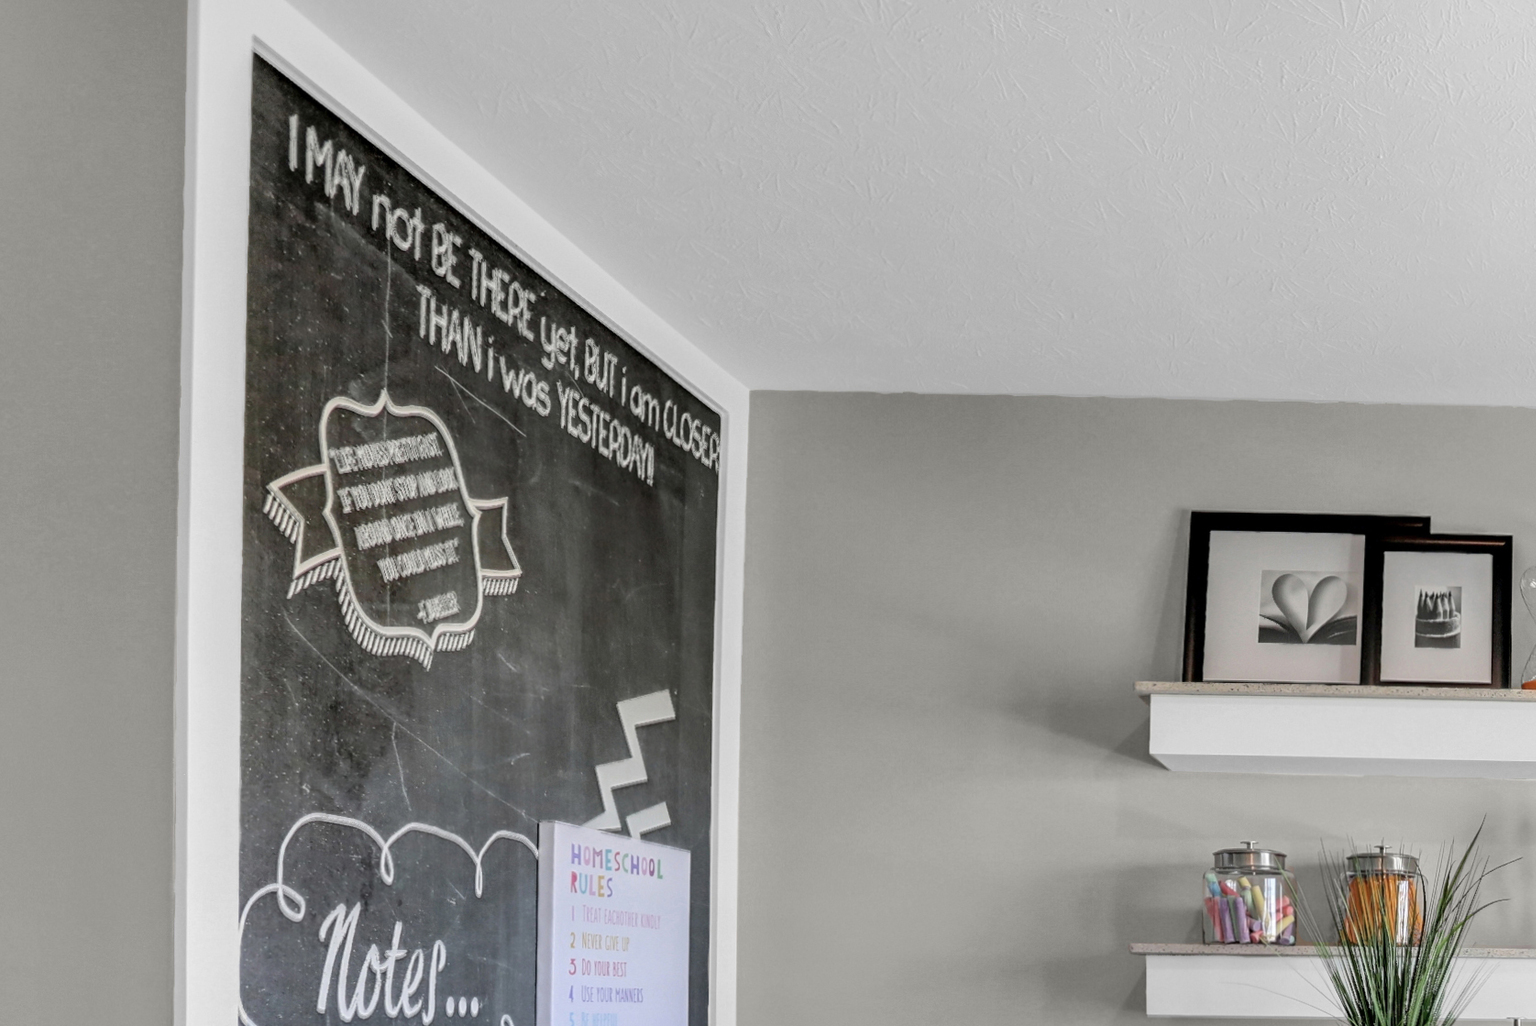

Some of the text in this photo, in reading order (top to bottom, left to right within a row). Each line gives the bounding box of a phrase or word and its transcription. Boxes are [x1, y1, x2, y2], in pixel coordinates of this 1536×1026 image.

[288, 114, 298, 172] I
[305, 125, 366, 216] MAY
[371, 194, 425, 262] not
[431, 222, 464, 290] BE
[468, 247, 537, 342] THERE
[584, 337, 619, 399] BUT
[629, 384, 661, 433] am
[662, 399, 721, 475] CLOSER
[415, 284, 482, 374] THAN
[500, 355, 552, 417] was
[571, 843, 664, 880] HOMESCHOOL
[570, 871, 613, 898] RULES
[582, 904, 602, 924] TREAT
[570, 932, 631, 952] 2 NEVER GIVE UP
[568, 958, 627, 978] 3 DO YOUR BEST
[568, 985, 644, 1003] 4 USE YOUR MANNERS
